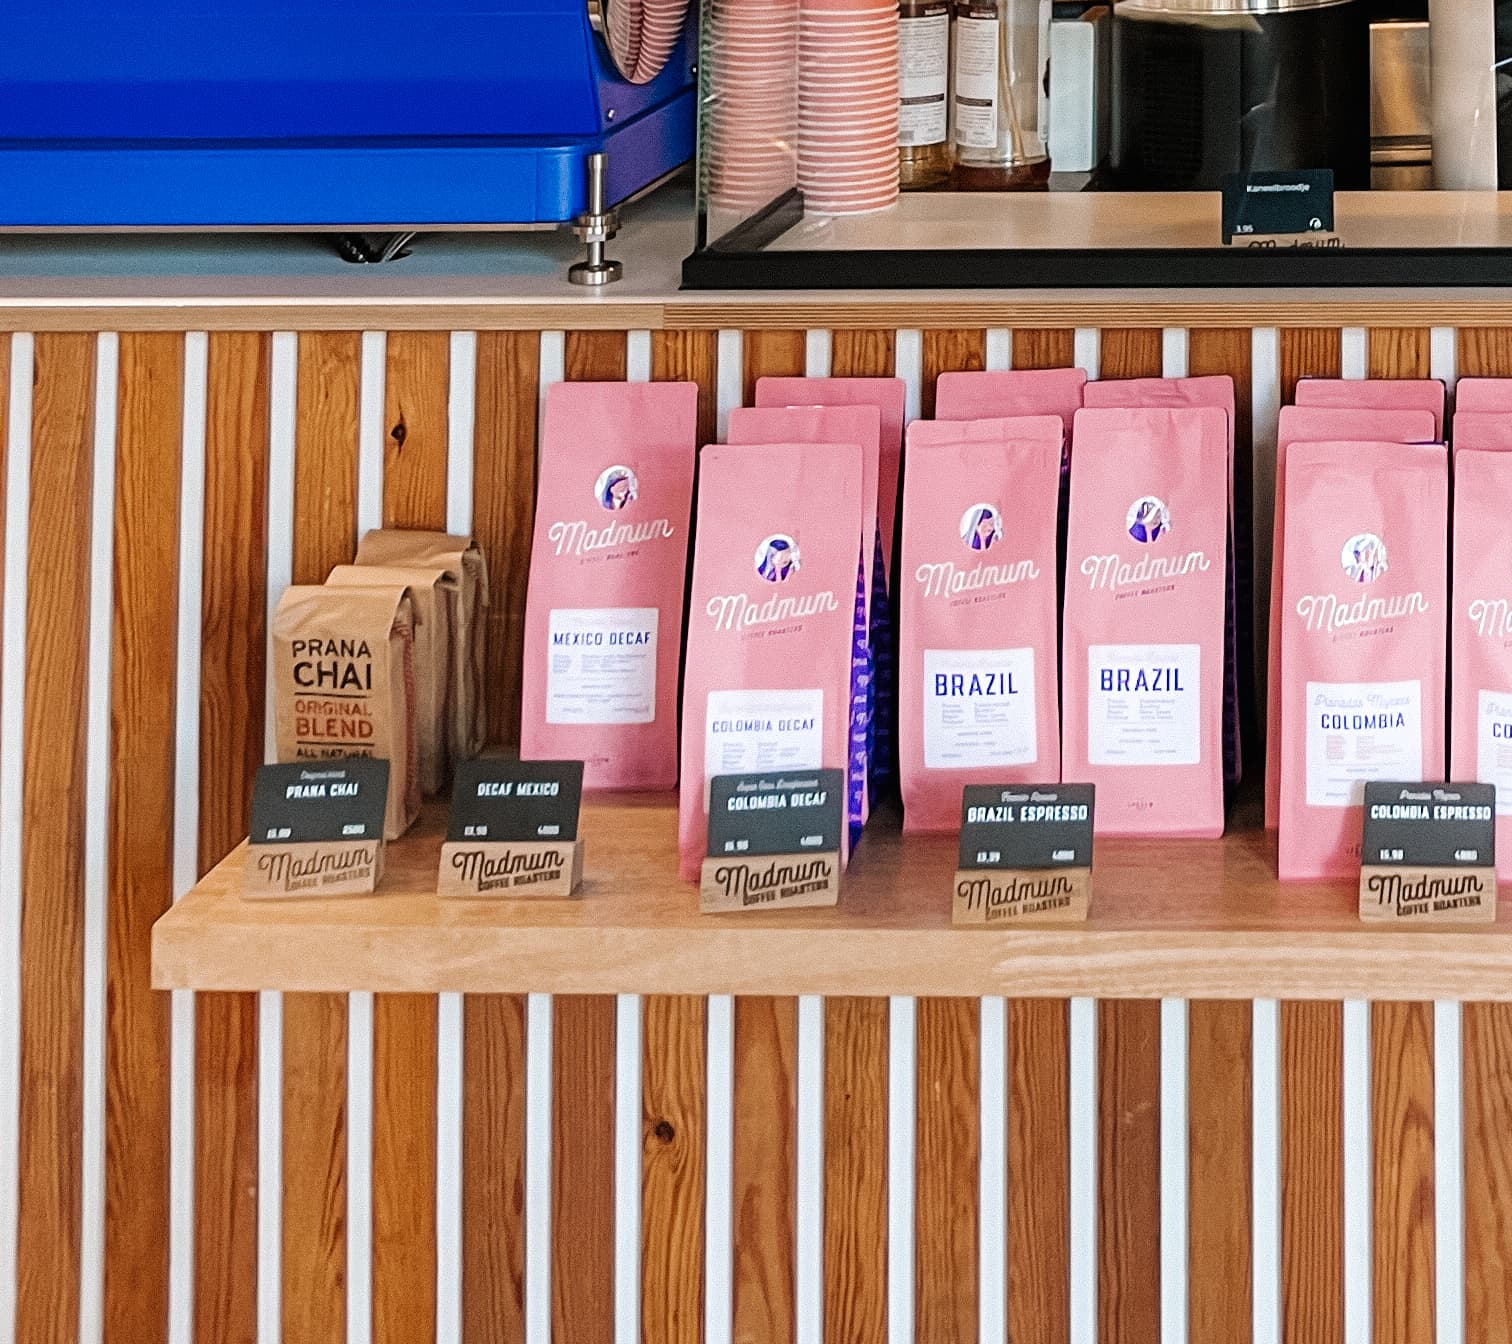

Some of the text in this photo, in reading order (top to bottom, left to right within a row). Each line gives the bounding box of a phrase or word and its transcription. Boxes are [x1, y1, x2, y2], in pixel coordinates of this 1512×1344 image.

[549, 518, 674, 557] Madmum
[915, 558, 1041, 599] Madmum
[1080, 550, 1211, 592] Madmum
[706, 590, 839, 633] Madmum
[1296, 590, 1429, 633] Madmum
[292, 639, 372, 659] PRANA
[553, 631, 651, 647] MEXICO DECAF
[293, 661, 372, 690] CHAI
[935, 673, 1019, 697] BRAZIL
[1100, 668, 1185, 692] BRAZIL
[295, 699, 372, 718] ORIGINAL
[296, 718, 374, 739] BLEND
[712, 718, 816, 734] COLOMBIA DECAF
[1320, 712, 1406, 730] COLOMBIA
[286, 782, 359, 800] PRANA CHAI
[477, 781, 559, 797] DECAF MEXICO
[727, 791, 827, 811] COLOMBIA DECAF
[967, 805, 1088, 823] BRAZIL ESPRESSO
[1370, 805, 1492, 820] COLOMBIA ESPRESSO
[258, 848, 374, 885] Madmum
[452, 849, 565, 883] Madmum
[715, 860, 832, 897] Madmum
[1368, 873, 1484, 906] Madmum
[957, 876, 1073, 911] Madmum
